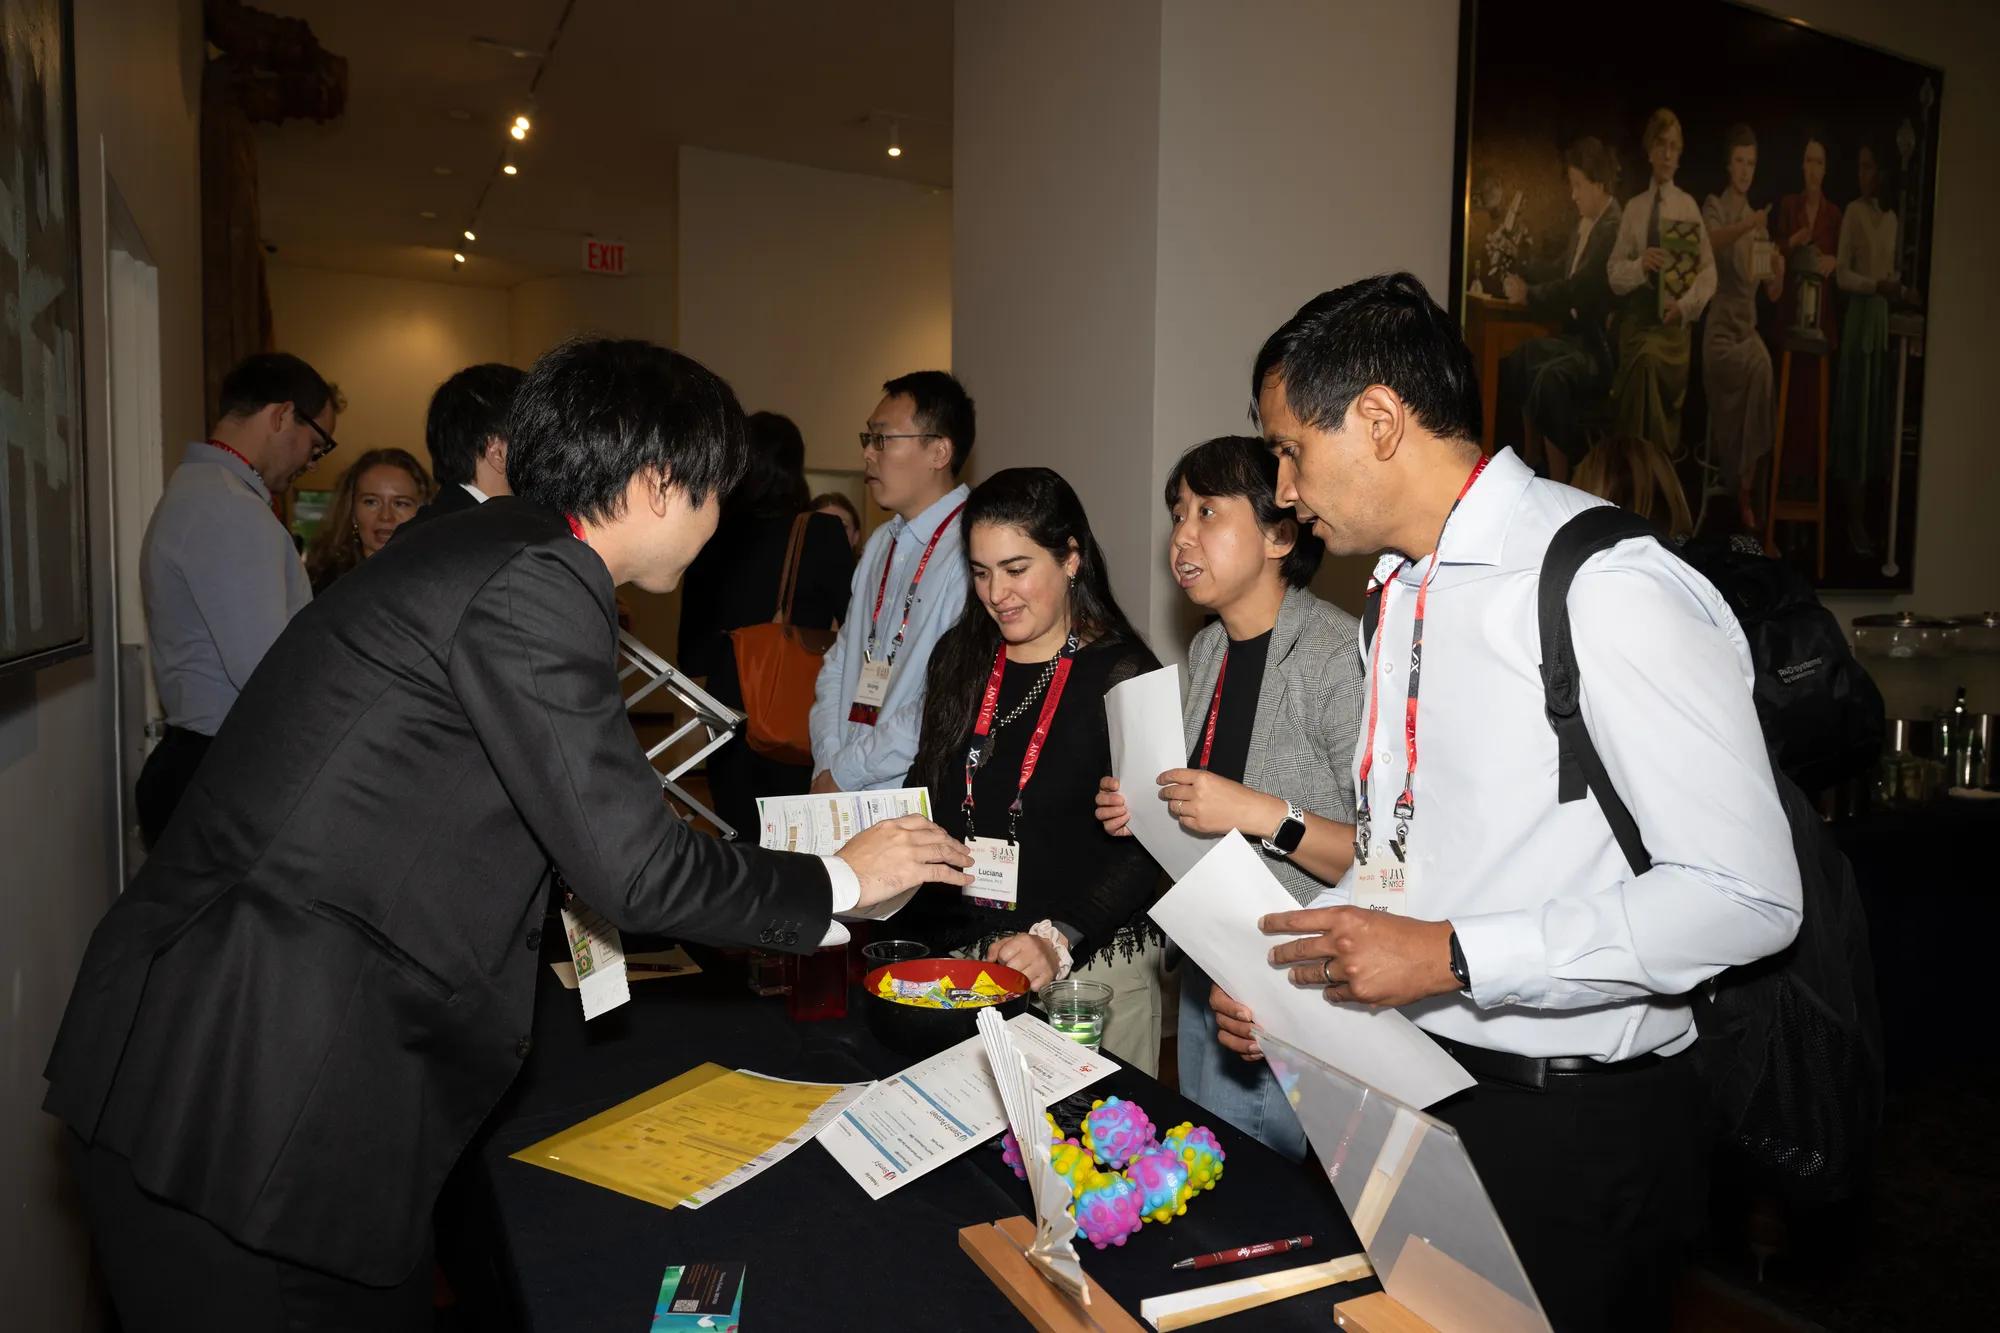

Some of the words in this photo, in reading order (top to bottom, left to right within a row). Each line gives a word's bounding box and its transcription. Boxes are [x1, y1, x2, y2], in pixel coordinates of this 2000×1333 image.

[588, 243, 624, 273] EXIT
[978, 867, 1003, 878] Luciana
[1369, 904, 1389, 912] Oscar
